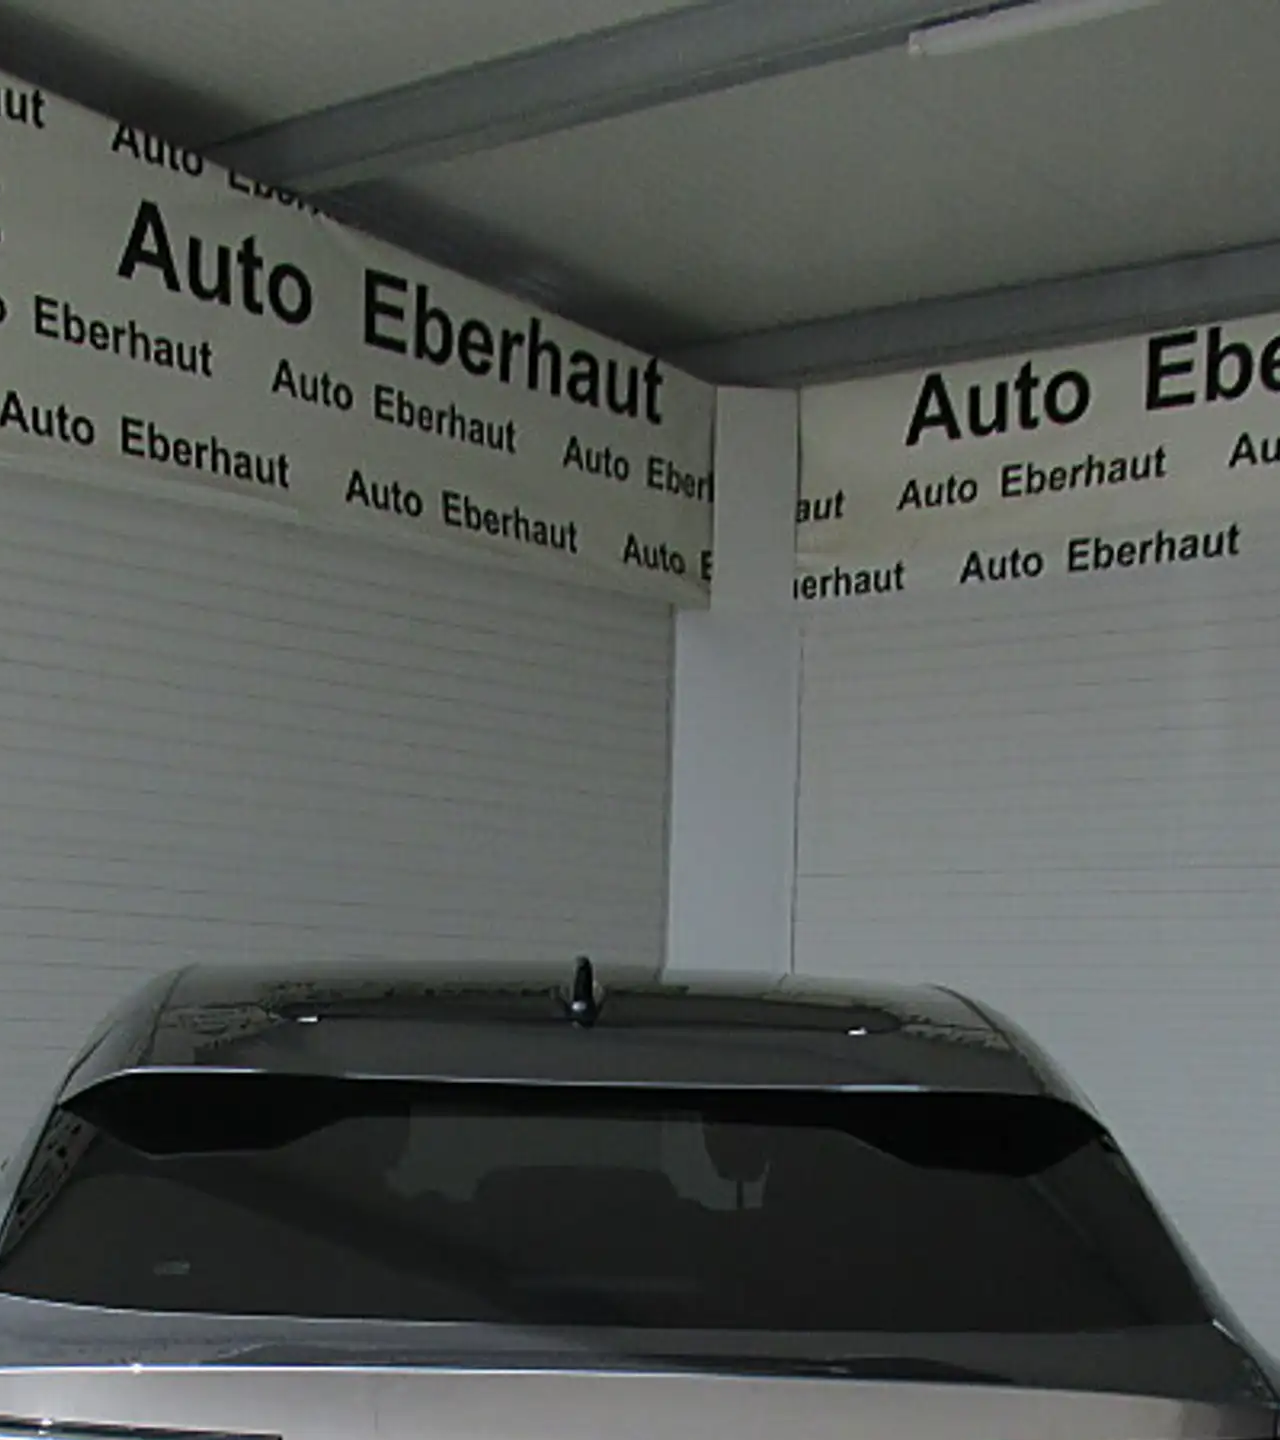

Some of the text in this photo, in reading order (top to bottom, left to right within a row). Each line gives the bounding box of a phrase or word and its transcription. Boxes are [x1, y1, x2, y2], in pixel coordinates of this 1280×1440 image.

[112, 124, 203, 176] Auto
[35, 296, 212, 377] Eberhaut
[119, 201, 663, 425] Auto Eberhaut
[0, 391, 288, 489] Auto Eberhaut
[272, 359, 515, 454] Auto Eberhaut
[906, 362, 1089, 446] Auto
[563, 436, 629, 481] Auto
[897, 447, 1165, 510] Auto Eberhaut
[346, 470, 577, 553] Auto Eberhaut
[623, 534, 685, 575] Auto
[794, 562, 904, 599] erhaut
[960, 524, 1239, 583] Auto Eberhaut
